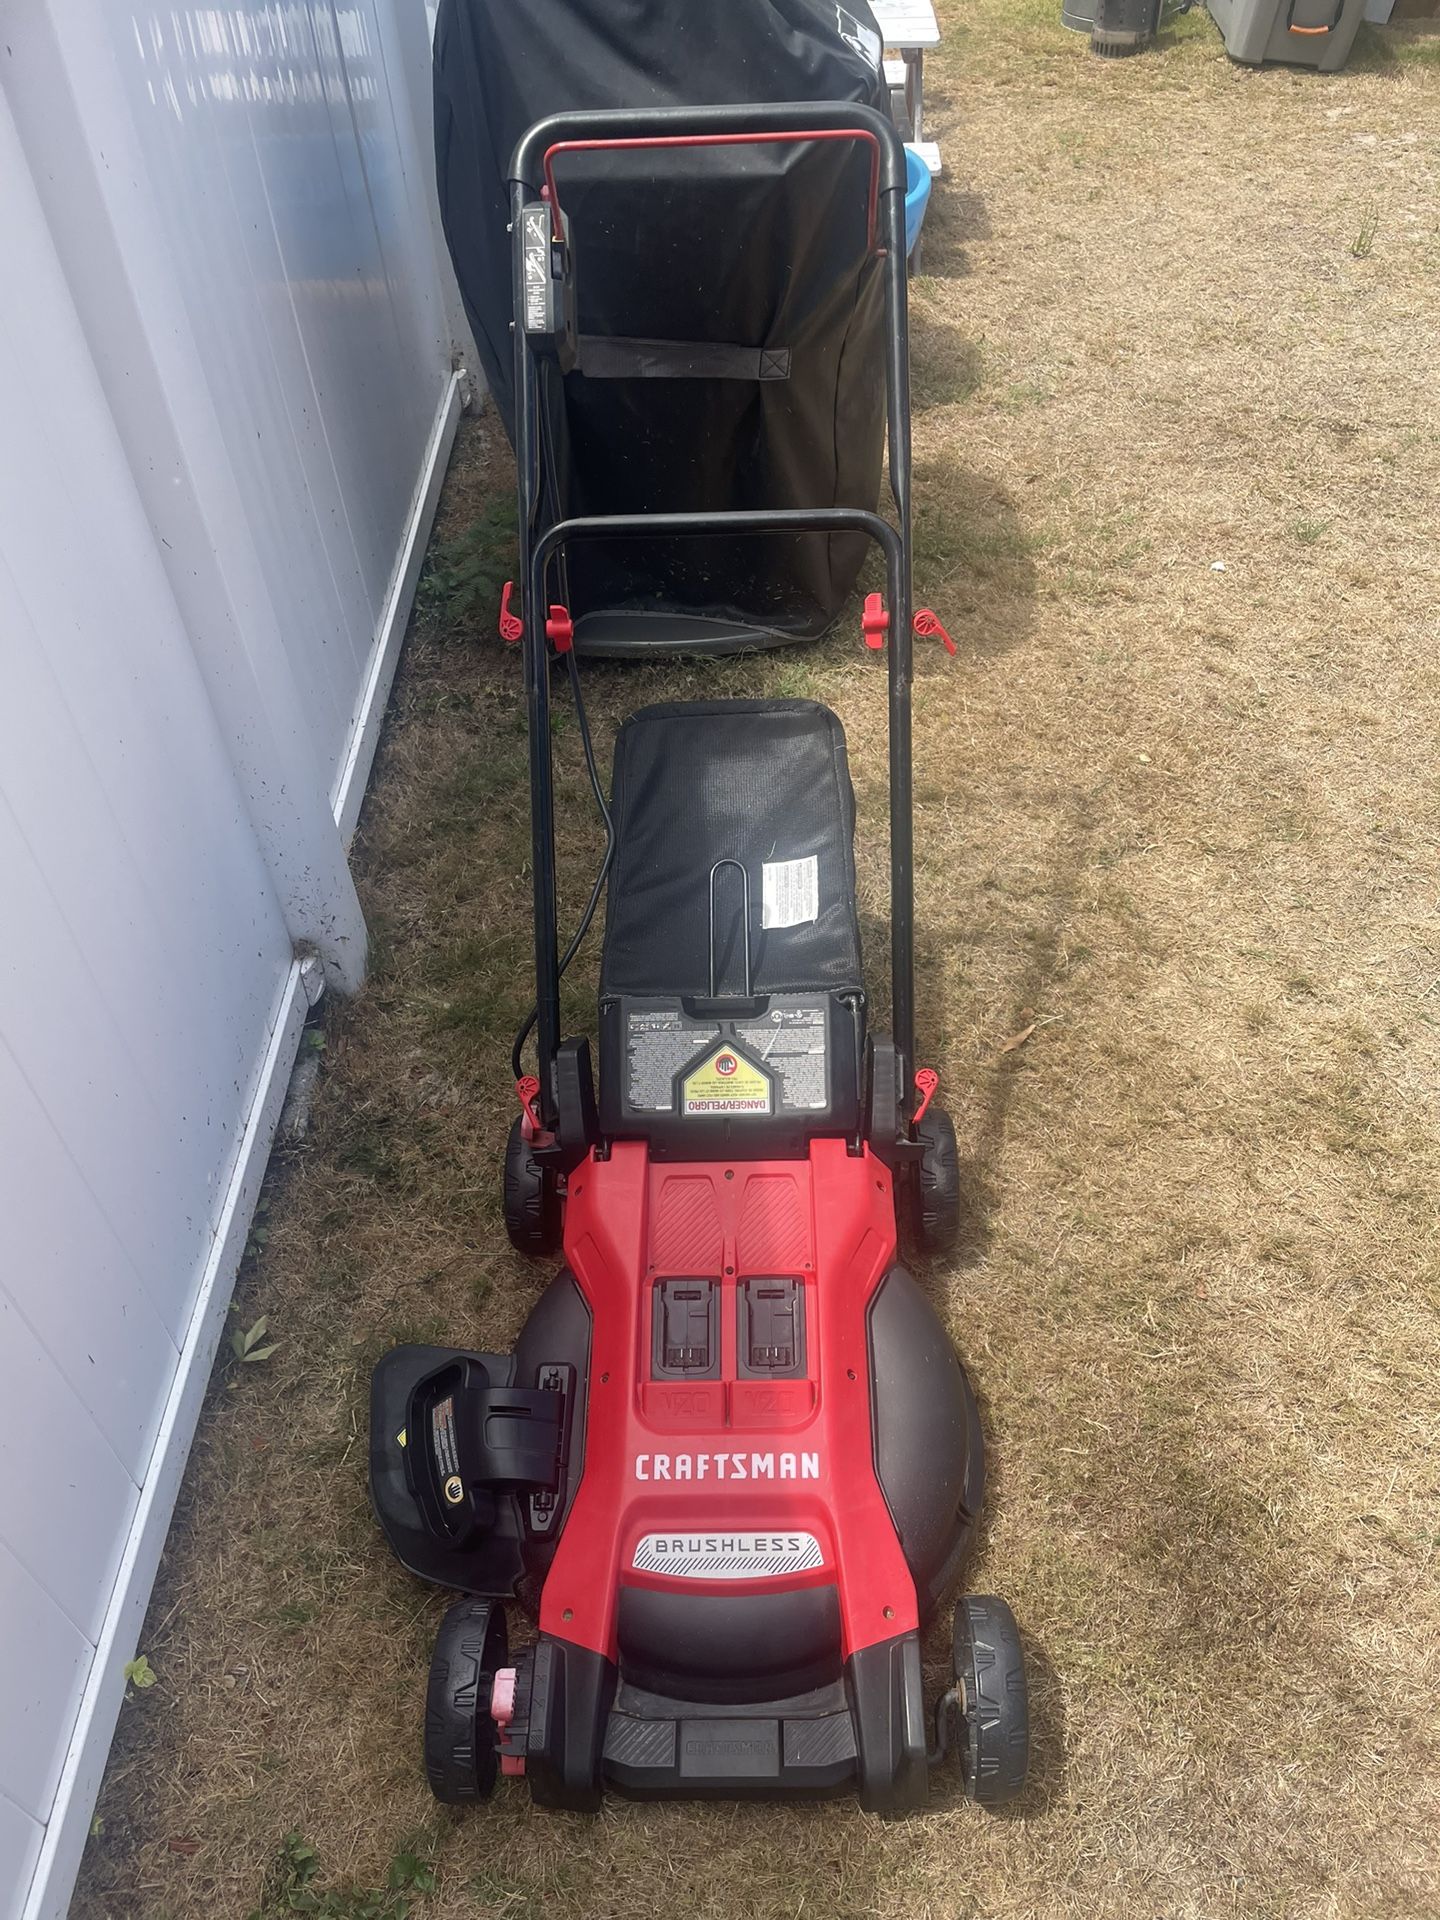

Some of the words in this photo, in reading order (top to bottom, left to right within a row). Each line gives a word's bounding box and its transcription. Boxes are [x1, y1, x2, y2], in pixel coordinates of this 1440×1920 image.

[689, 1100, 766, 1111] DANGER/PELIGRO
[635, 1452, 820, 1480] CRAFTSMAN
[655, 1538, 801, 1553] BRUSHLESS
